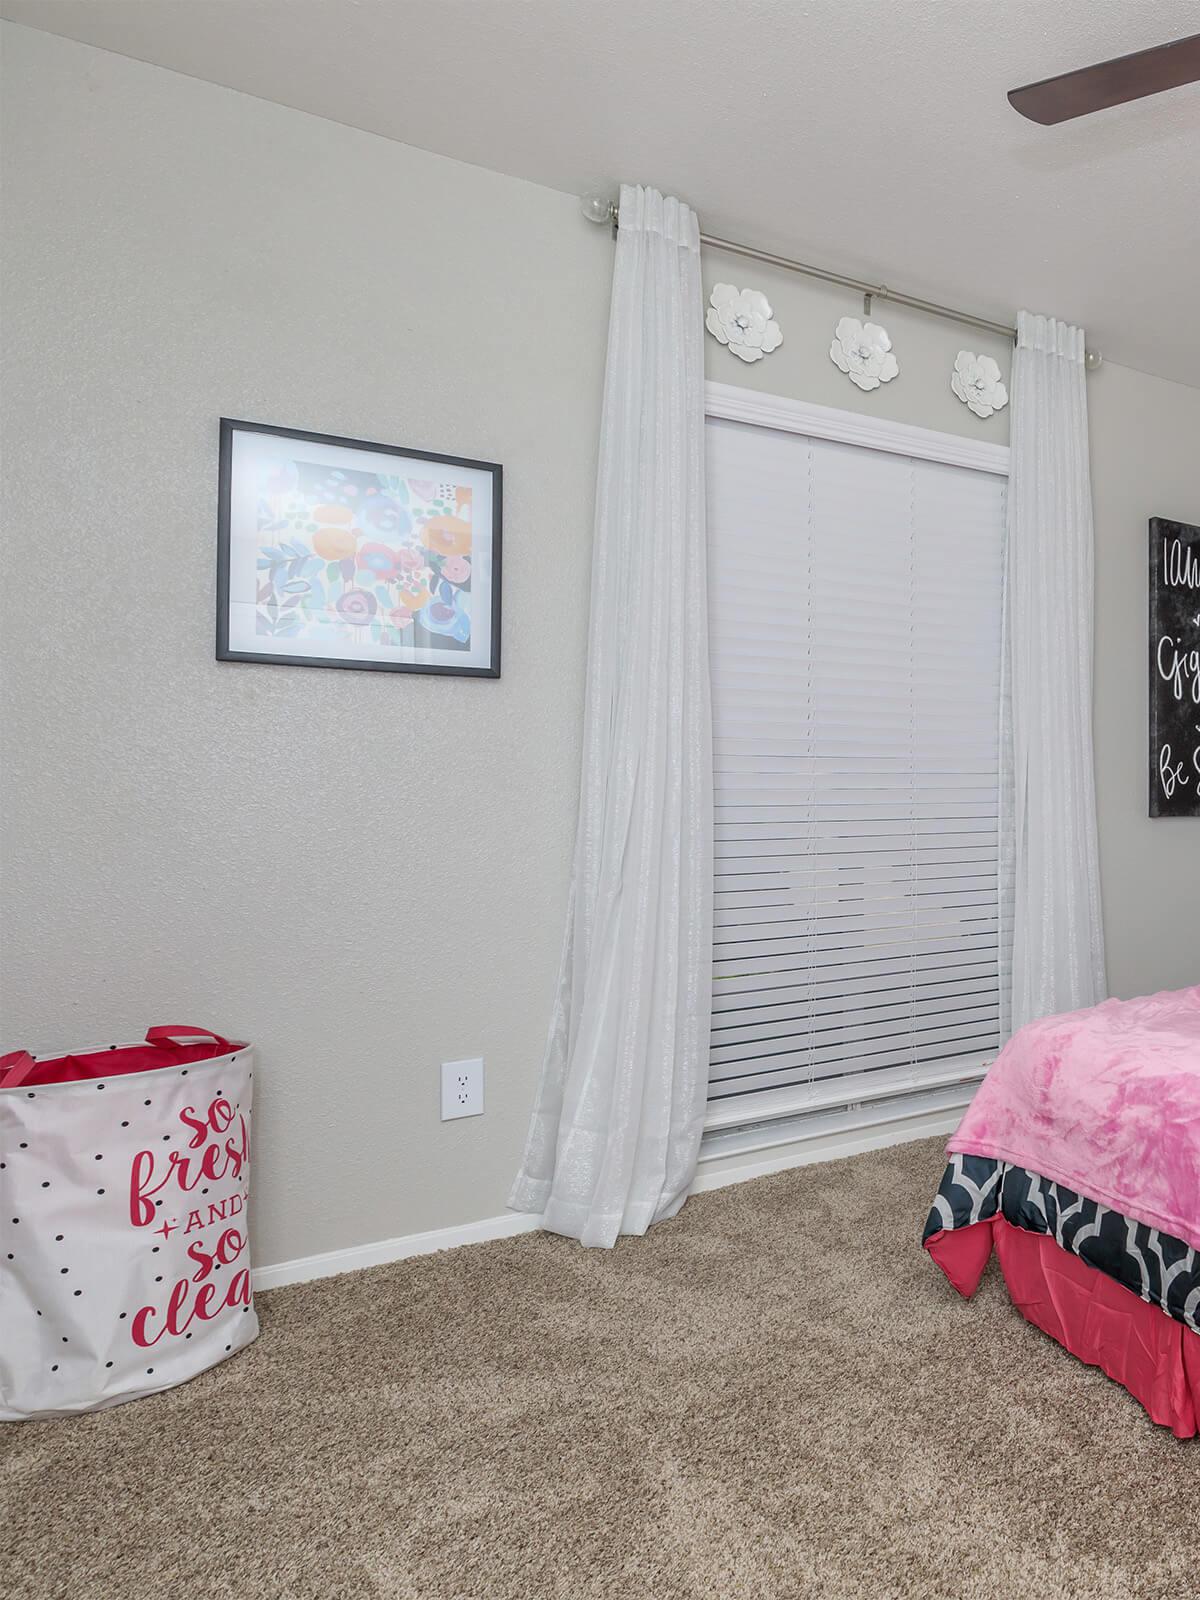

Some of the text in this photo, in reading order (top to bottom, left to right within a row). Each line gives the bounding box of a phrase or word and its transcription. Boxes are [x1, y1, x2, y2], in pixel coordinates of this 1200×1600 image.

[1160, 744, 1190, 800] Be
[179, 1098, 237, 1149] so
[183, 1193, 243, 1235] AND
[187, 1228, 248, 1283] so
[131, 1268, 252, 1348] clea
